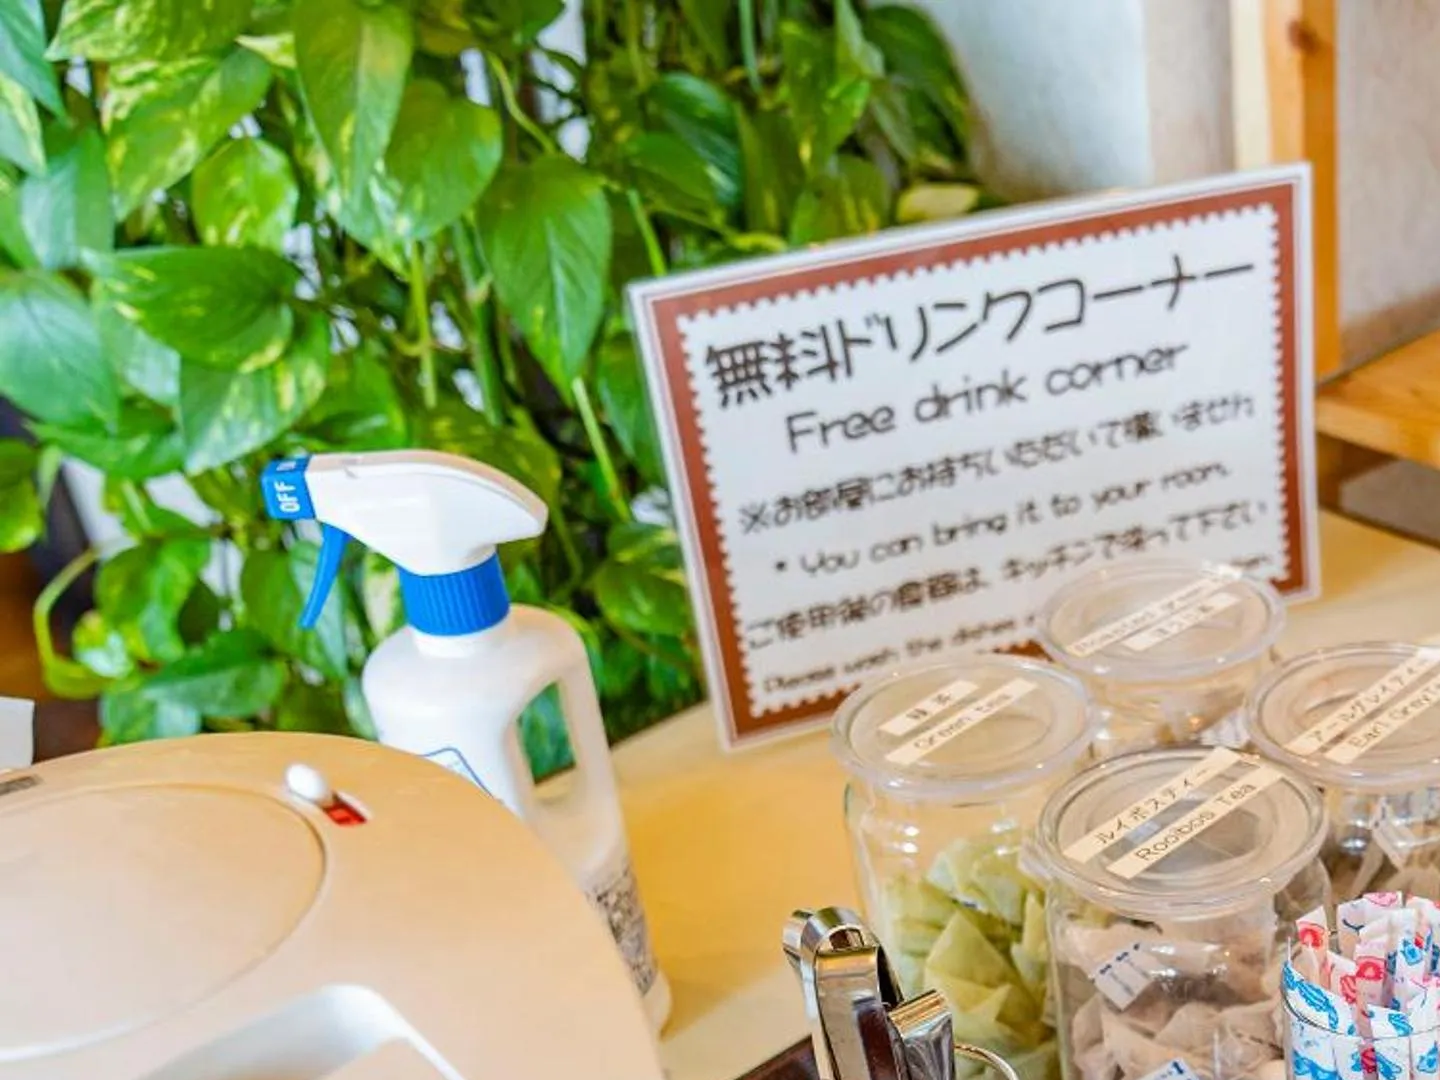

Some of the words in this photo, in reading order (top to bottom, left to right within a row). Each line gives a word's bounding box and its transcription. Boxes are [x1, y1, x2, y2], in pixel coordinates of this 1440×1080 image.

[706, 254, 1255, 407] 無料ドリンクコーナー
[786, 406, 896, 454] Free
[914, 369, 1027, 423] drink
[1046, 342, 1188, 397] corner
[274, 479, 301, 513] OFF
[869, 534, 924, 564] can
[931, 513, 1008, 546] bring
[1017, 498, 1041, 524] it
[1050, 495, 1081, 518] to
[1090, 478, 1152, 512] your
[1348, 720, 1389, 749] Earl
[1094, 768, 1209, 845] ルイボスティー
[1134, 810, 1216, 861] Rooibos
[1215, 783, 1257, 807] Tea
